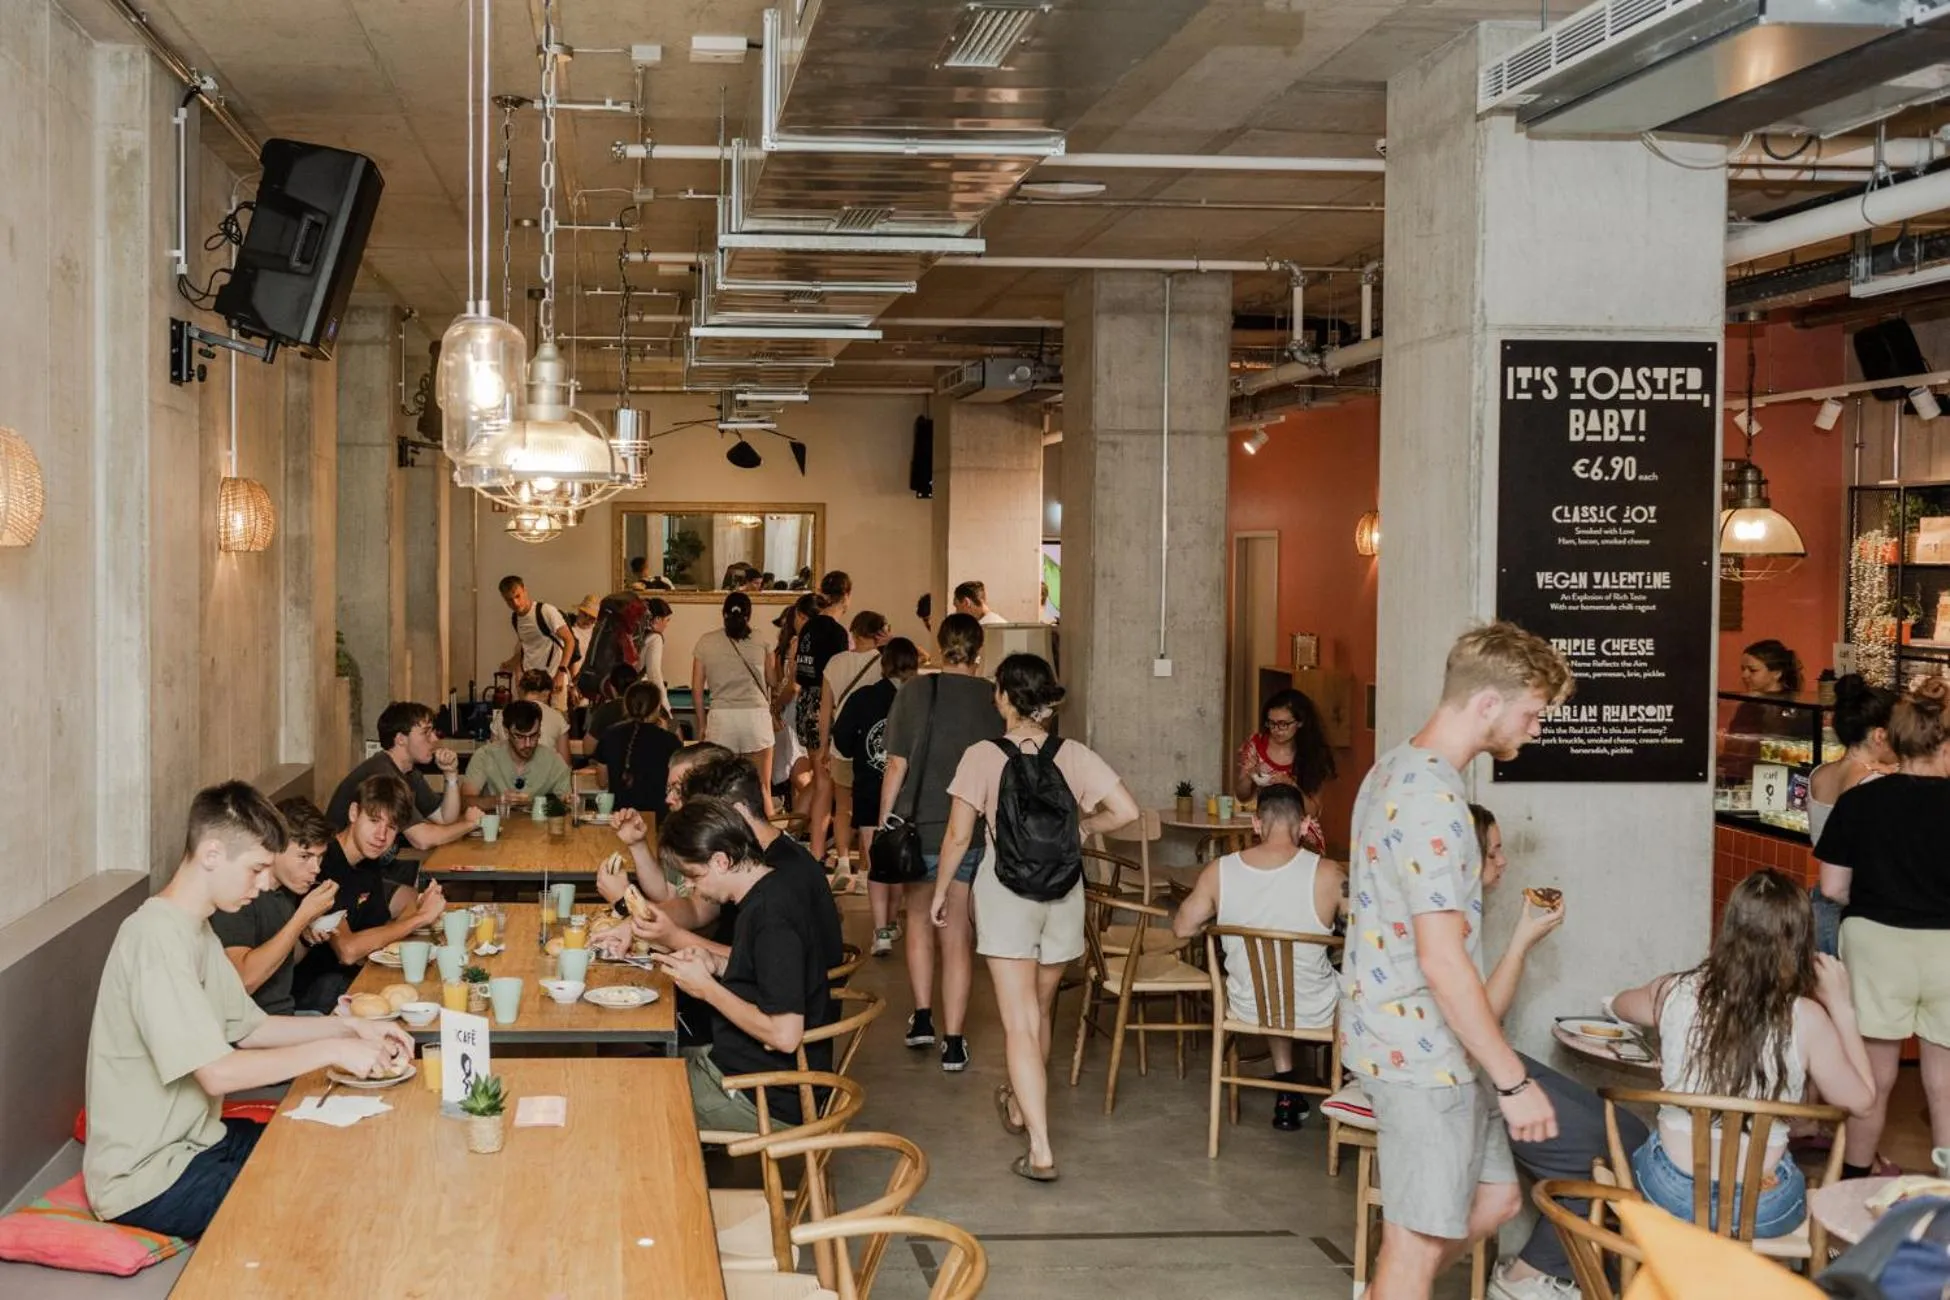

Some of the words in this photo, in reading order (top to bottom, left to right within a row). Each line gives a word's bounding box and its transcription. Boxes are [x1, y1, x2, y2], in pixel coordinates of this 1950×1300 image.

[1507, 366, 1559, 400] IT'S
[1570, 366, 1710, 408] TOASTED,
[1569, 408, 1646, 442] BABY!
[1572, 456, 1637, 481] €6.90
[1638, 472, 1659, 481] each
[1622, 505, 1657, 523] JOY
[1575, 526, 1603, 535] Smoked
[1603, 527, 1618, 535] with
[1619, 526, 1635, 535] Love
[1558, 537, 1577, 546] Ham,
[1578, 537, 1600, 546] bacon,
[1600, 537, 1627, 545] smoked
[1627, 537, 1650, 545] cheese
[1536, 571, 1588, 589] VEGAN
[1560, 592, 1571, 601] An
[1572, 592, 1604, 602] Explosion
[1604, 592, 1612, 601] of
[1613, 592, 1629, 601] Rich
[1630, 592, 1647, 601] Taste
[1550, 603, 1567, 611] With
[1580, 603, 1618, 611] homemade
[1601, 638, 1655, 656] CHEESE
[1571, 660, 1591, 668] Name
[1592, 660, 1620, 668] Reflects
[1620, 660, 1632, 668] the
[1633, 660, 1648, 668] Aim
[1570, 670, 1591, 678] heese,
[1627, 670, 1642, 679] brie,
[1643, 670, 1666, 680] pickles
[1602, 705, 1674, 722] RHAPSODY
[1542, 726, 1555, 734] this
[1556, 726, 1568, 734] the
[1568, 726, 1584, 734] Real
[1584, 726, 1602, 734] Life?
[1609, 726, 1622, 734] this
[1623, 726, 1637, 734] Just
[1638, 726, 1668, 737] Fantasy?
[1541, 736, 1557, 746] pork
[1558, 736, 1586, 745] knuckle,
[1587, 736, 1613, 745] smoked
[1660, 737, 1684, 745] cheese
[1610, 746, 1634, 756] pickles
